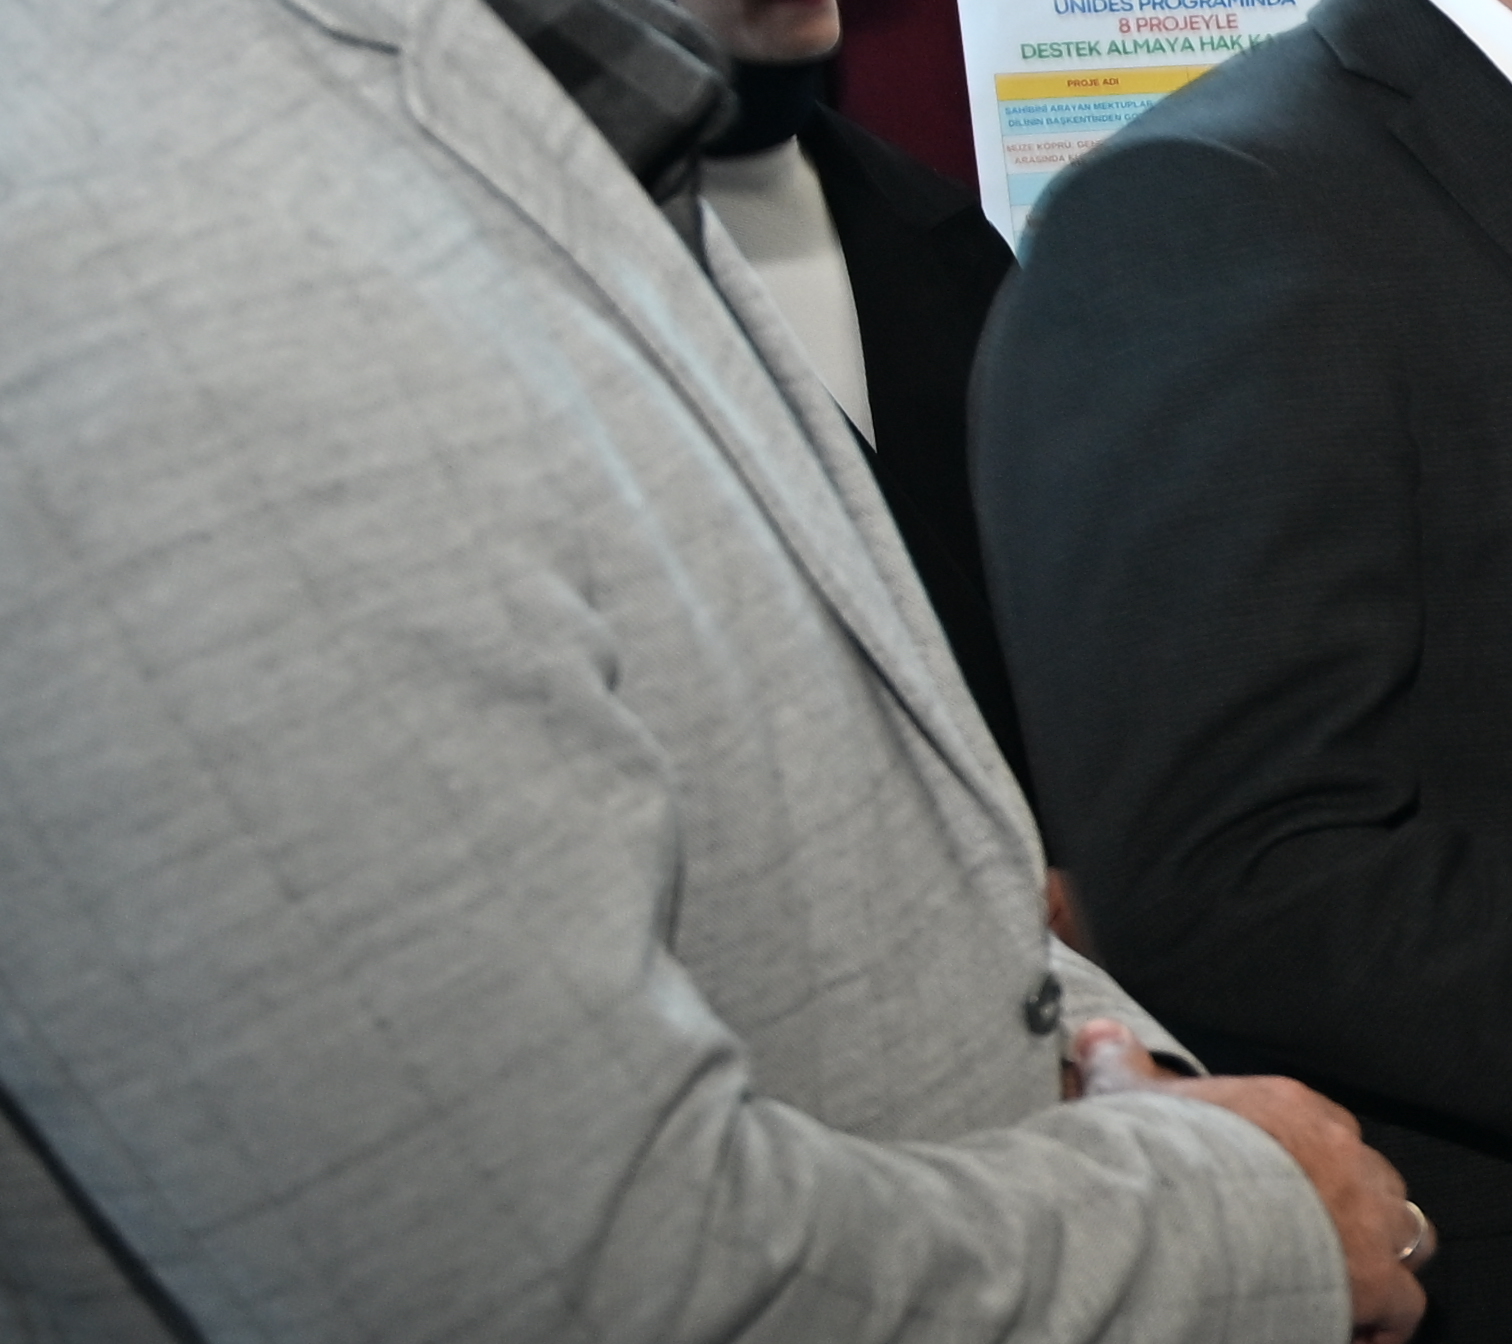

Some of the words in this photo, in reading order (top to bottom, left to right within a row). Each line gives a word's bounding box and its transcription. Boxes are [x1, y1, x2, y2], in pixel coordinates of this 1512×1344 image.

[1118, 17, 1132, 34] 8
[1137, 13, 1239, 33] PROJEYLE
[1021, 40, 1101, 60] DESTEK
[1107, 37, 1196, 56] ALMAYA
[1200, 33, 1243, 53] HAK
[1067, 78, 1101, 88] PROJE
[1102, 77, 1120, 87] ADI
